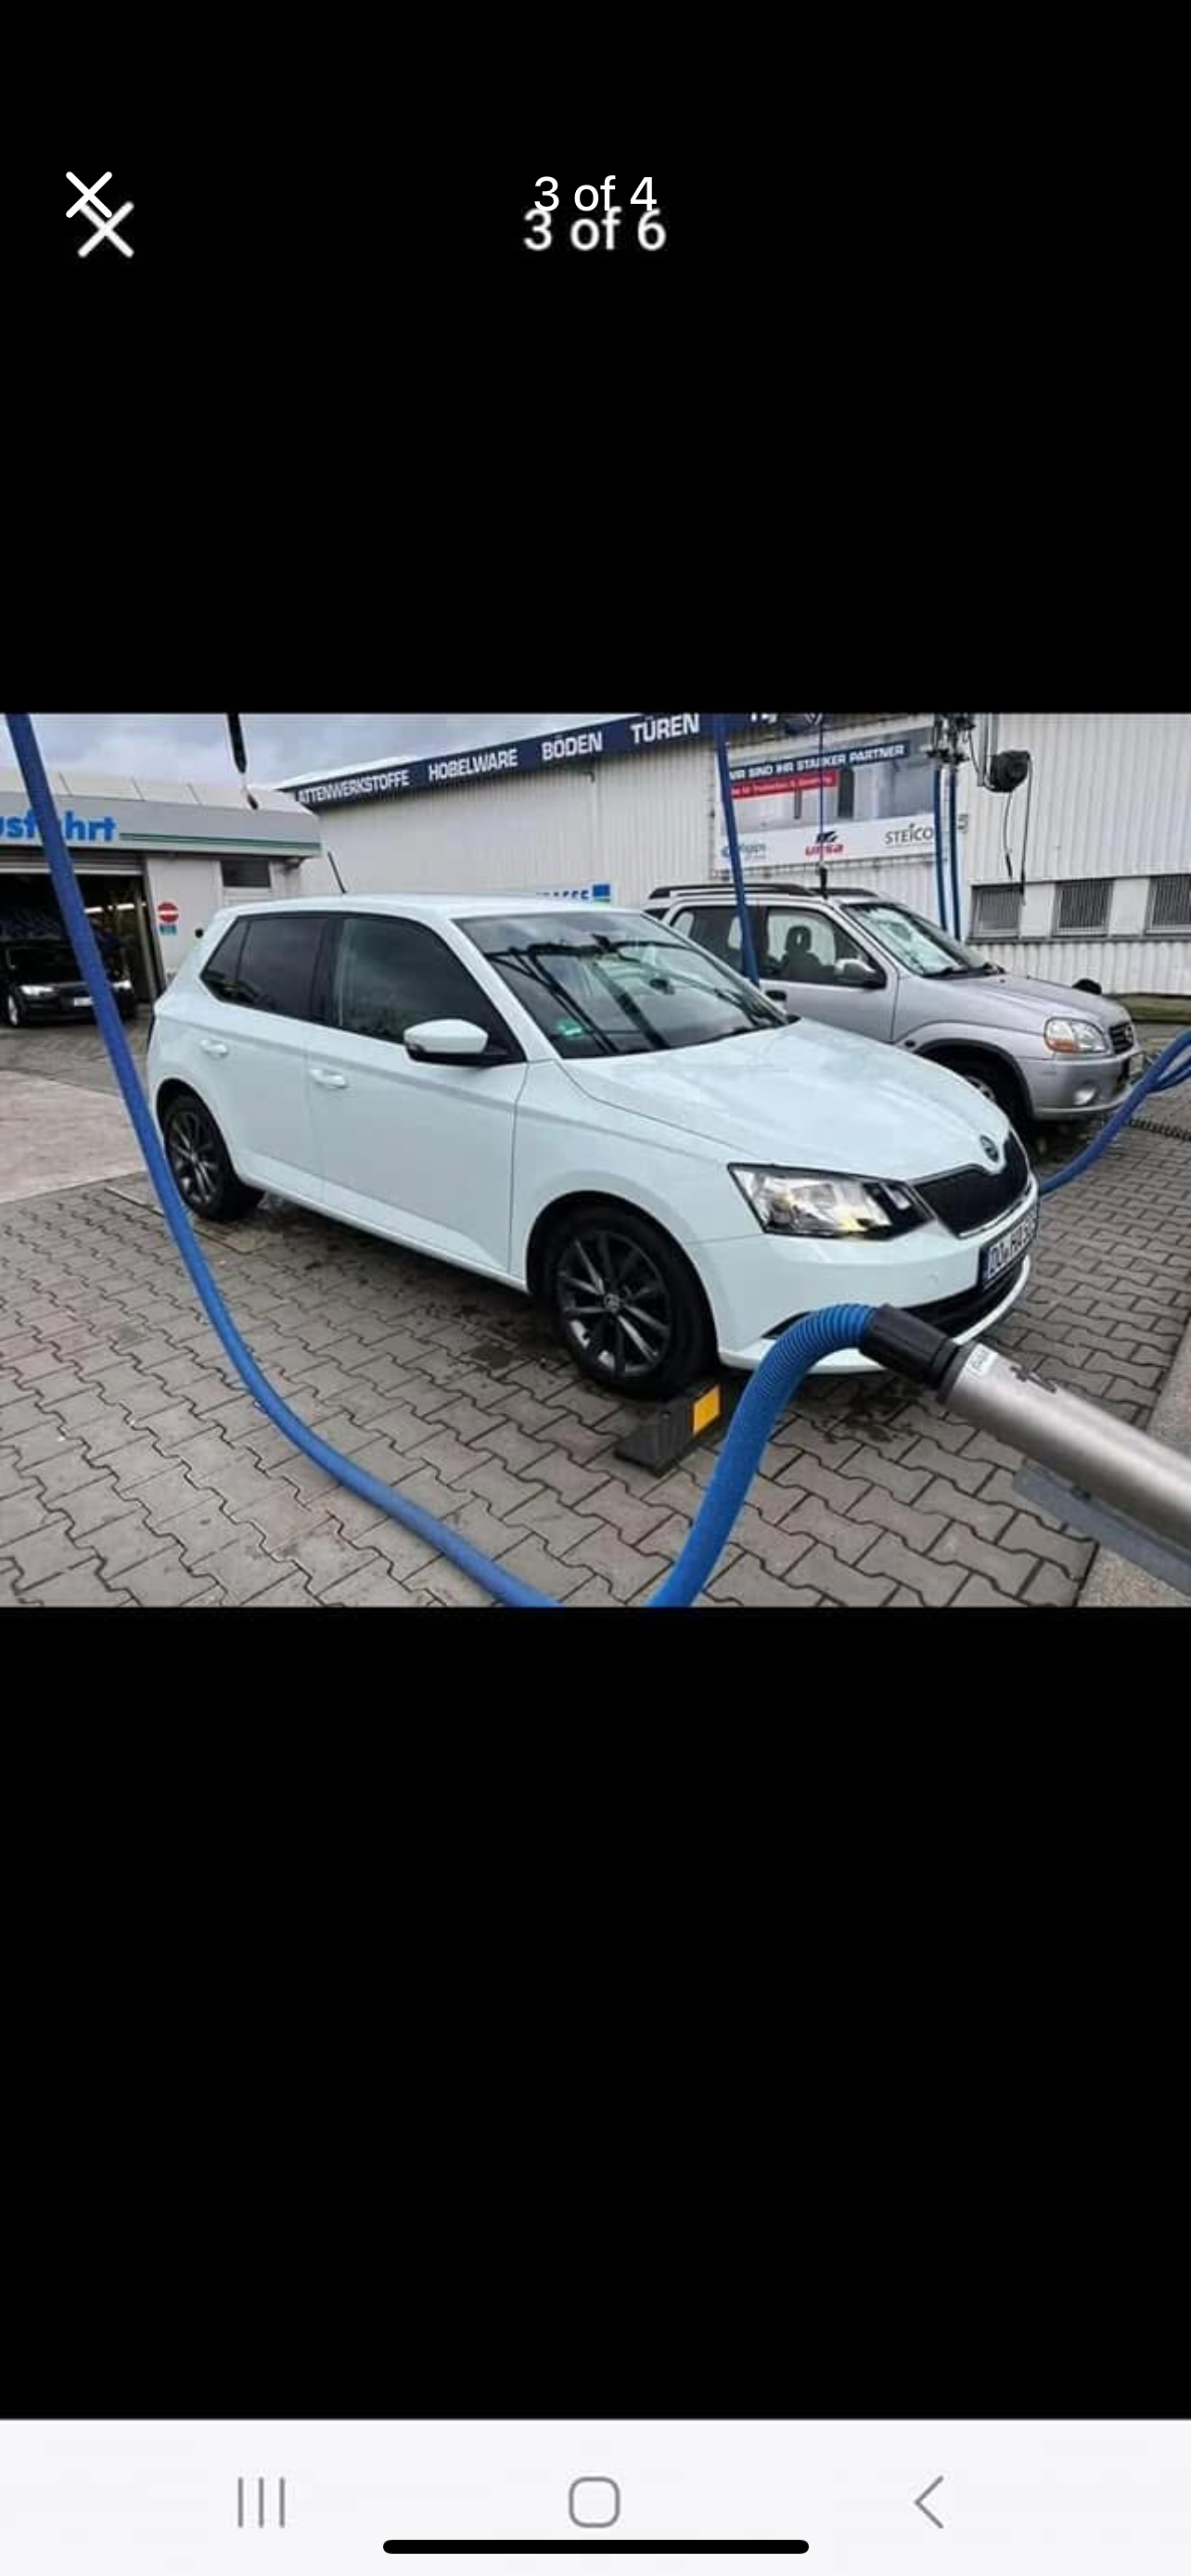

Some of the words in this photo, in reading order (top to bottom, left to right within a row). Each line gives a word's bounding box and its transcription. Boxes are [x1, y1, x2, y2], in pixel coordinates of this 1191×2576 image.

[428, 748, 519, 782] HOBELWARE
[541, 730, 603, 760] BÖDEN
[630, 712, 699, 745] TÜREN
[850, 745, 905, 761] PARTNER
